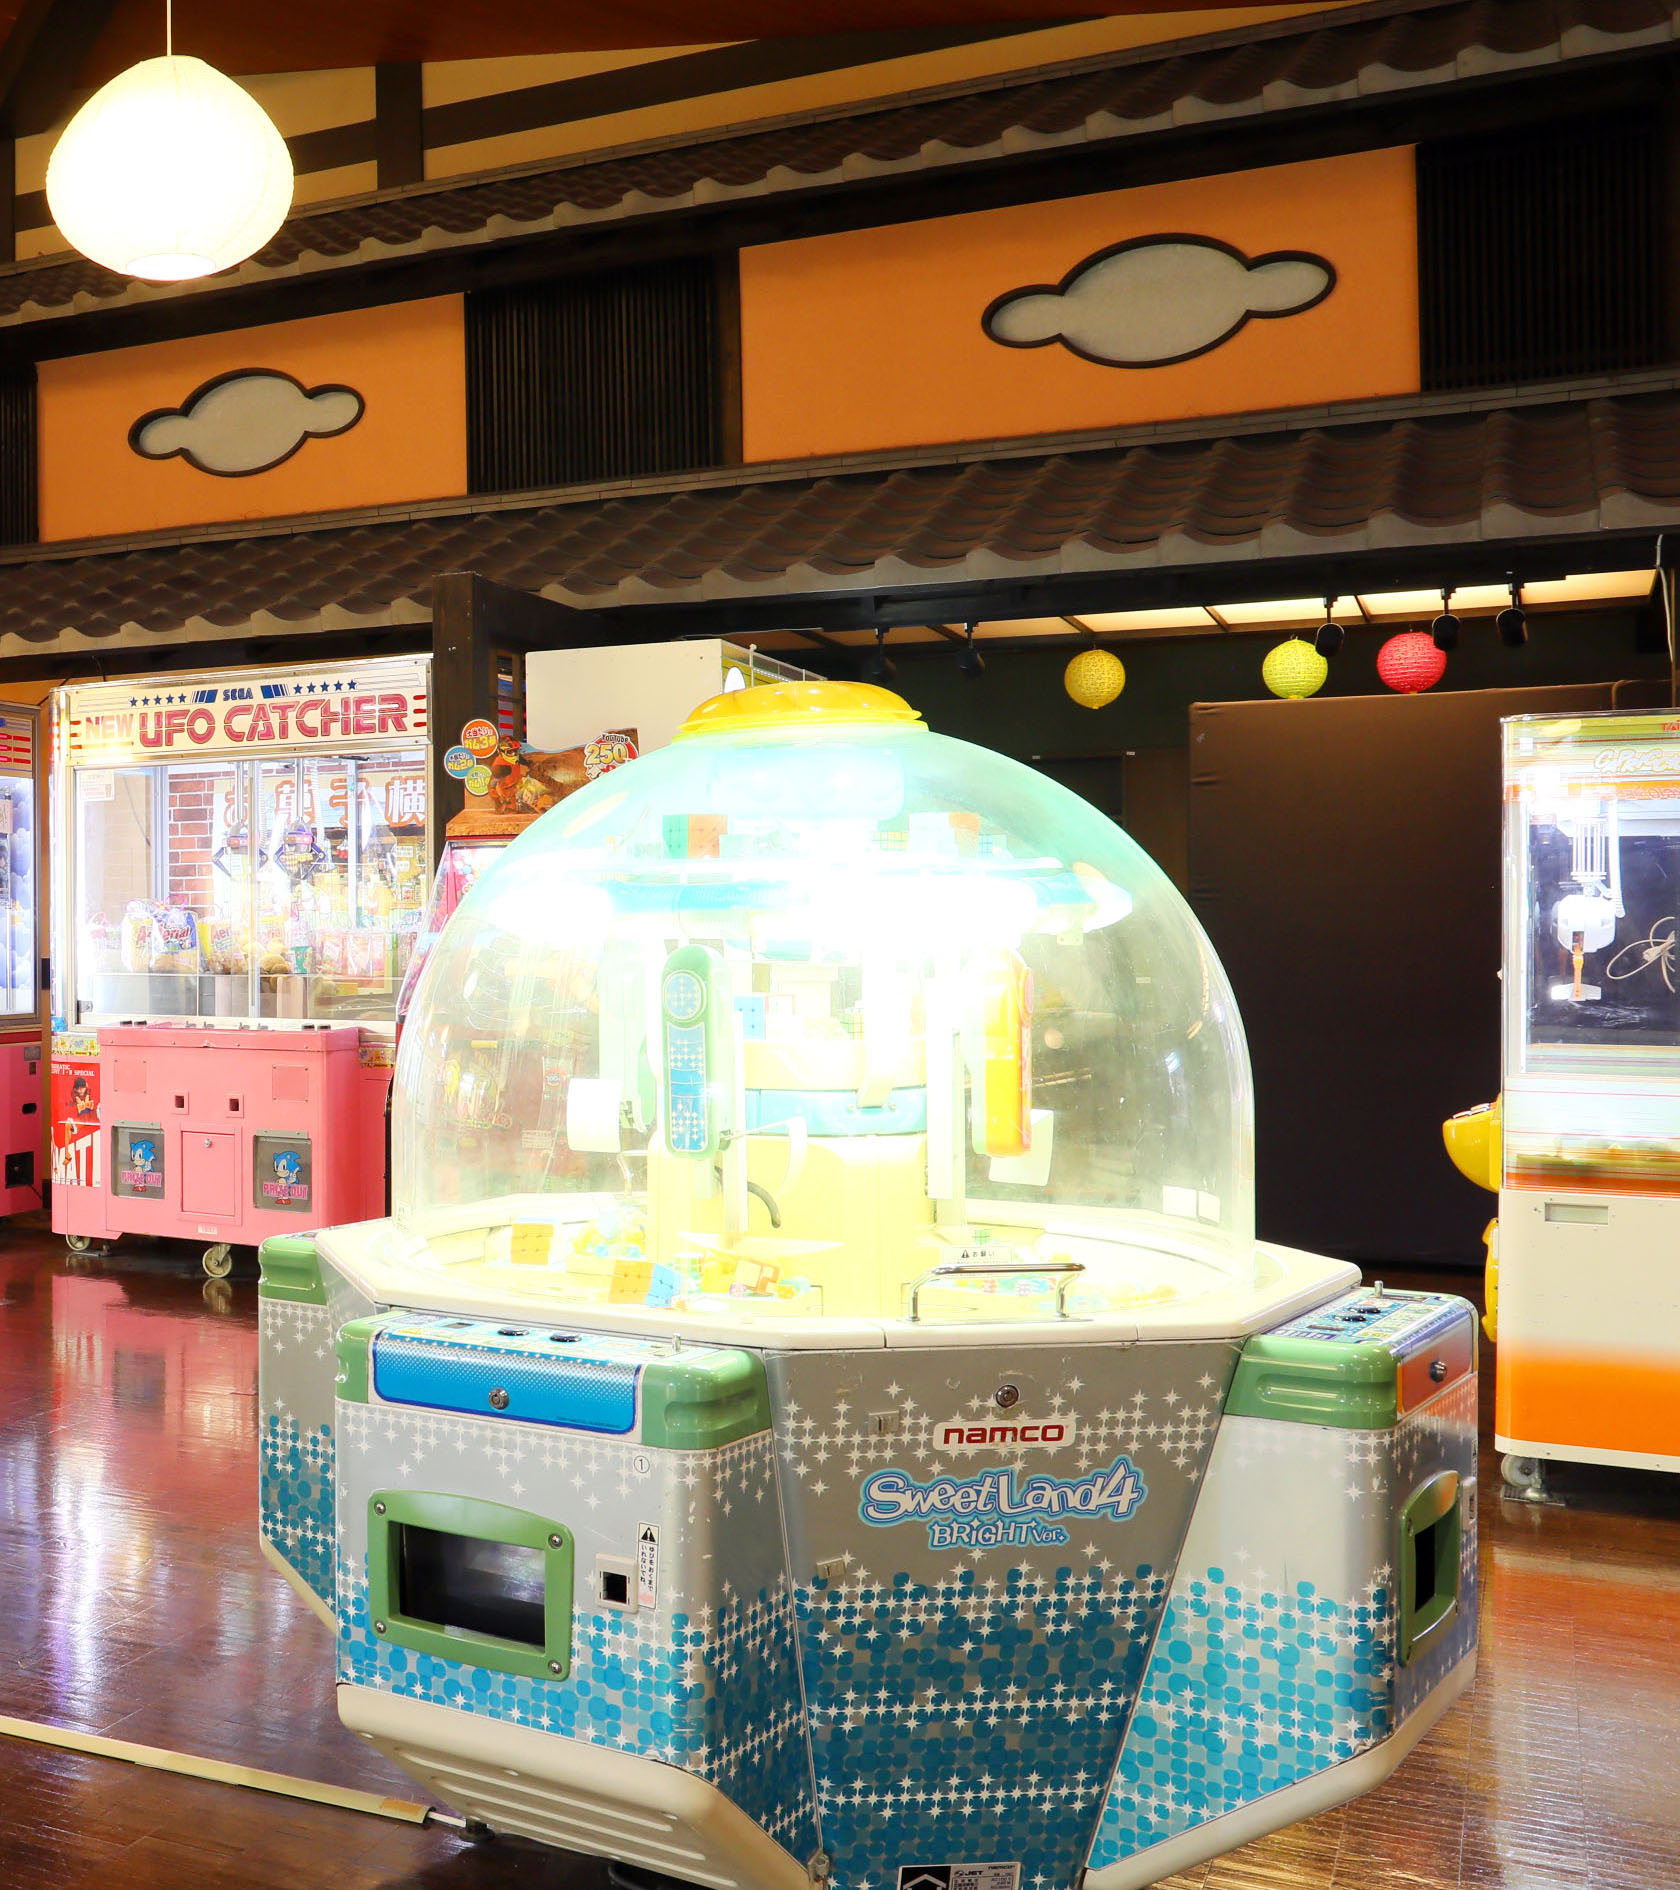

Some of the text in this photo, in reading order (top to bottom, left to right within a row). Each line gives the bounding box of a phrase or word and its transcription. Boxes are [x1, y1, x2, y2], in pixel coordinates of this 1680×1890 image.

[222, 687, 253, 701] SEGA
[85, 694, 408, 748] NEW UFO CATCHER
[586, 743, 628, 766] 250
[145, 1172, 162, 1187] OUT
[263, 1183, 308, 1200] PRIZE OUT
[943, 1424, 1065, 1445] namco
